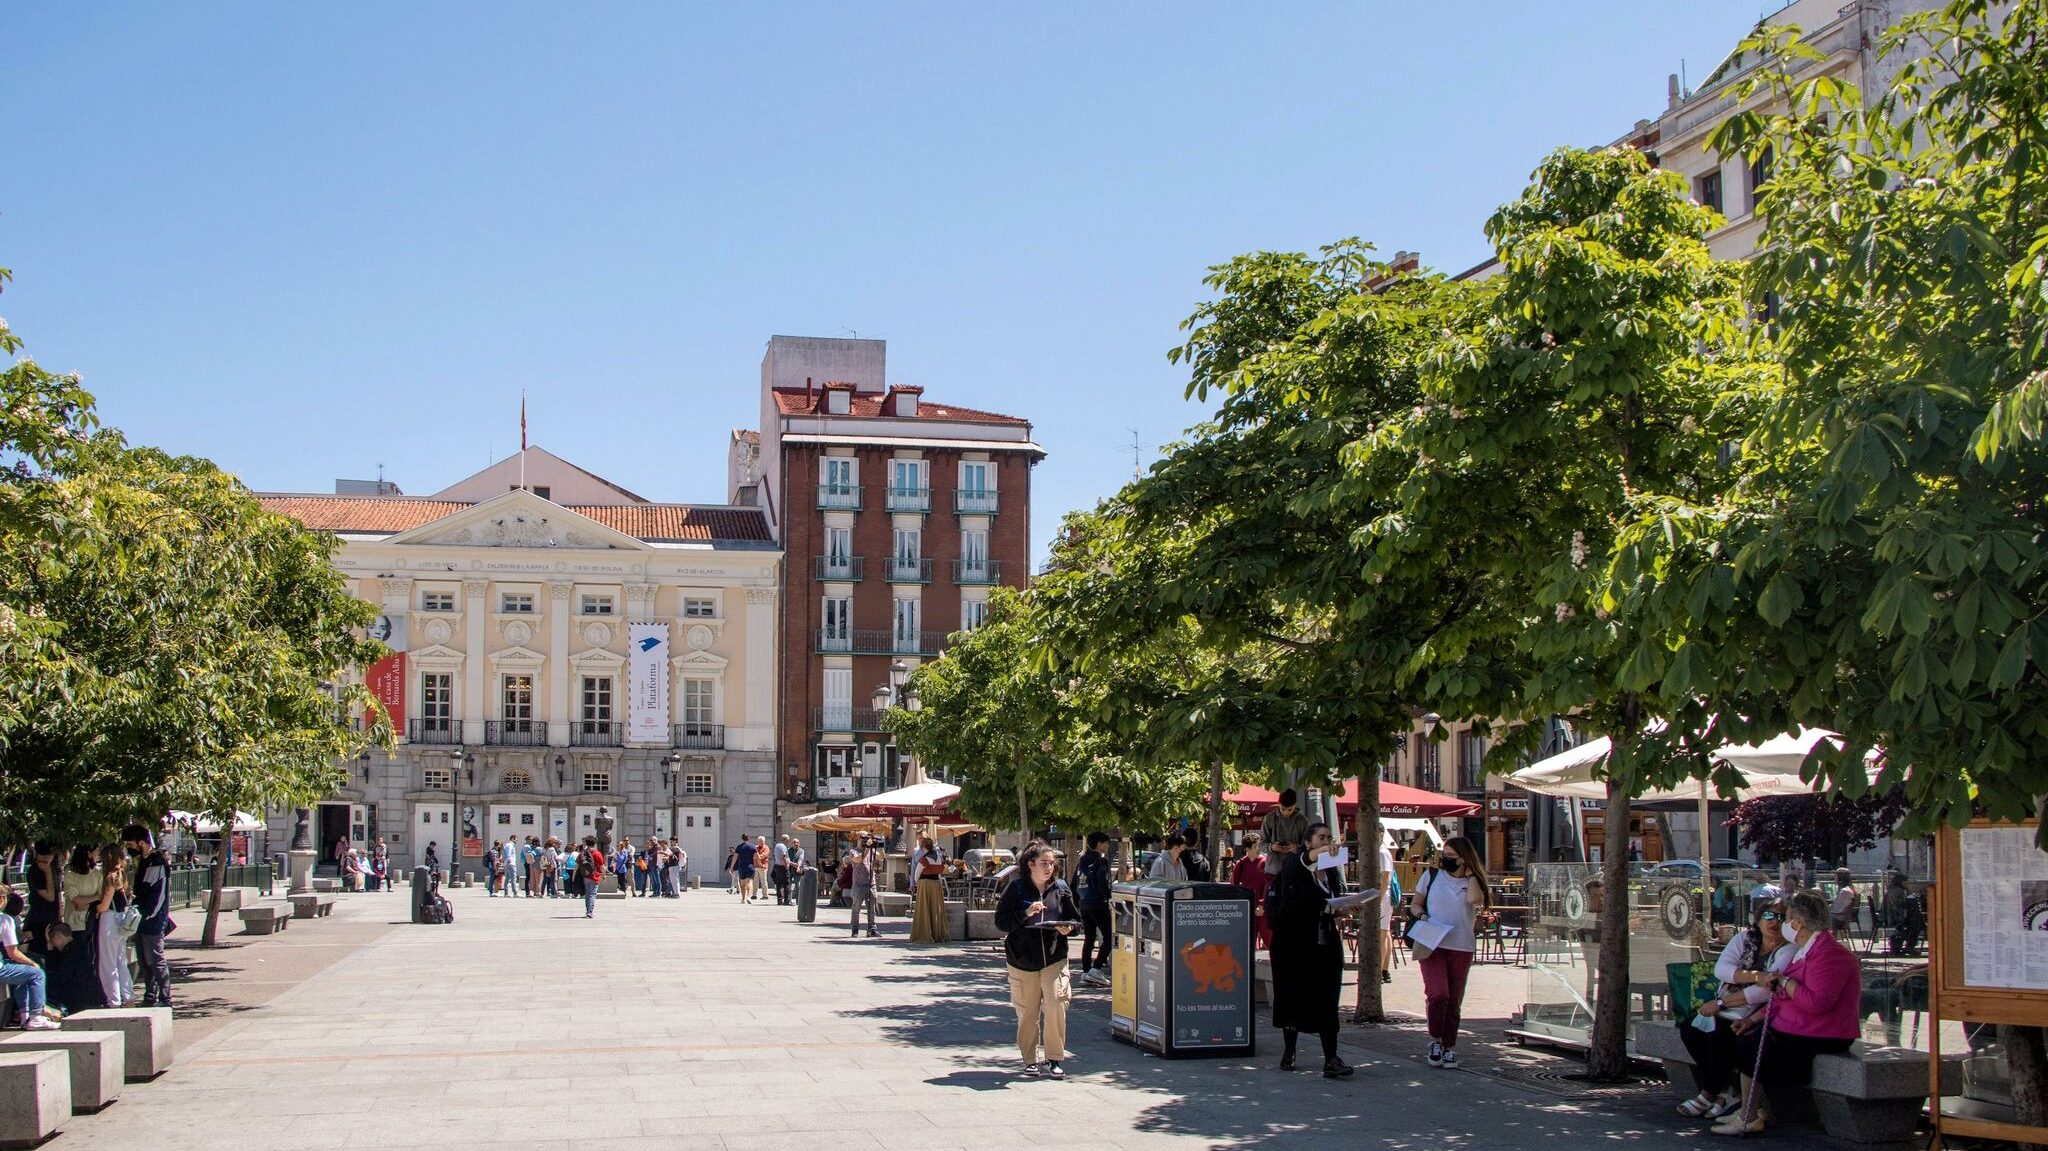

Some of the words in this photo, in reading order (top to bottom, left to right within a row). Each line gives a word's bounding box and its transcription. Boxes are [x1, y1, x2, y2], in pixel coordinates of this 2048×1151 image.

[384, 672, 392, 681] de
[648, 664, 656, 709] Plataforma
[1252, 802, 1258, 811] 7
[1414, 805, 1420, 814] 7
[1176, 903, 1194, 911] Cada
[1194, 903, 1222, 912] papelera
[1215, 910, 1242, 919] Deposita
